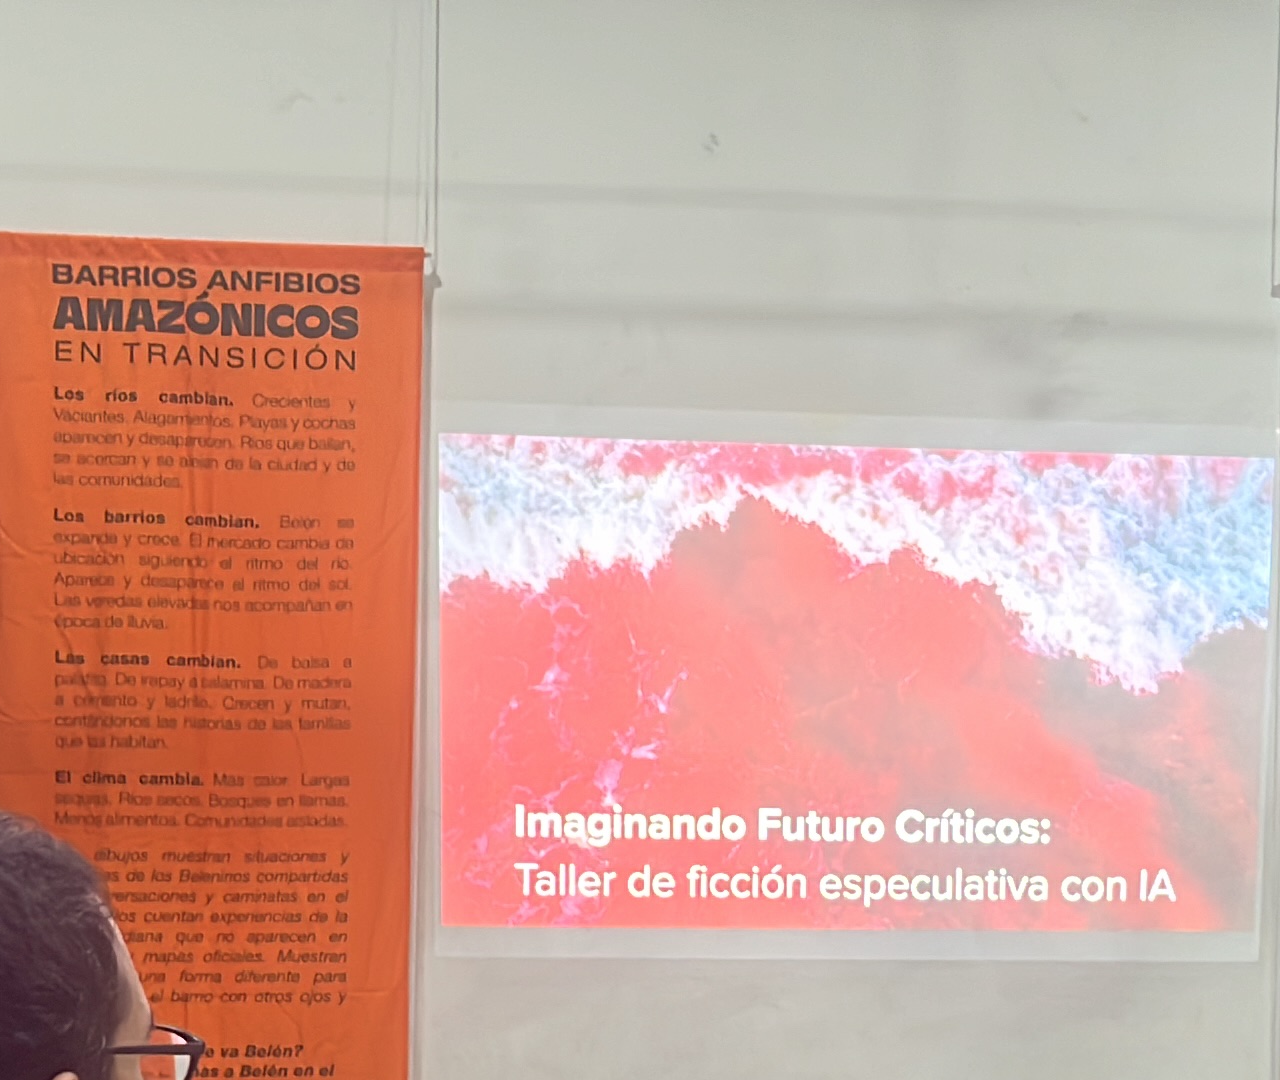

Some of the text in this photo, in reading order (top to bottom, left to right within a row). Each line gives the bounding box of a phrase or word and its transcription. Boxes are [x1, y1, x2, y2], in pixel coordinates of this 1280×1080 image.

[52, 263, 361, 296] BARRIOS ANFIBIOS
[53, 289, 359, 339] AMAZÓNICOS
[55, 340, 357, 371] EN TRANSICIÓN
[54, 386, 84, 401] Los
[159, 391, 234, 407] cambian.
[348, 399, 356, 412] y
[239, 414, 356, 432] Playas y cochas
[126, 434, 305, 452] y que
[142, 456, 355, 474] y de la ciudad y de
[54, 508, 84, 522] Los
[104, 510, 166, 524] barrios
[185, 513, 260, 529] cambian.
[123, 534, 132, 548] y
[207, 537, 271, 550] mercado
[276, 538, 330, 550] cambia
[246, 556, 283, 571] ritmo
[296, 557, 319, 571] del
[123, 575, 132, 590] y
[252, 578, 290, 592] ritmo
[298, 577, 321, 592] del
[213, 599, 240, 612] nos
[104, 616, 124, 629] de
[55, 650, 85, 665] Las
[100, 653, 150, 666] casas
[166, 653, 241, 669] cambian.
[257, 655, 279, 669] De
[115, 672, 137, 686] De
[273, 675, 294, 690] De
[147, 696, 292, 714] y Crecen y
[247, 718, 266, 731] de
[55, 770, 71, 784] El
[82, 771, 127, 785] clima
[139, 771, 204, 786] cambia.
[514, 803, 1052, 848] Imaginando Futuro Críticos:
[161, 849, 231, 863] muestran
[244, 850, 327, 864] situaciones
[340, 851, 351, 866] y
[125, 868, 145, 883] de
[150, 868, 172, 883] los
[256, 870, 349, 887] compartidas
[514, 863, 1177, 907] Taller de ficción especulativa con IA
[205, 893, 214, 906] y
[223, 891, 298, 904] caminatas
[307, 892, 326, 904] en
[335, 889, 350, 904] el
[143, 911, 204, 923] cuentan
[210, 911, 302, 926] experiencias
[309, 910, 329, 923] de
[336, 909, 348, 924] la
[176, 932, 204, 946] que
[216, 932, 235, 943] no
[247, 931, 317, 946] aparecen
[328, 932, 348, 943] en
[143, 949, 347, 967] mapas Muestran
[180, 969, 222, 984] forma
[235, 969, 301, 984] diferente
[313, 972, 347, 986] para
[150, 988, 164, 1004] el
[220, 991, 247, 1004] con
[254, 991, 293, 1004] otros
[300, 990, 332, 1006] ojos
[338, 991, 347, 1006] y
[220, 1046, 239, 1058] va
[244, 1044, 304, 1059] Belén?
[223, 1066, 235, 1078] a
[239, 1064, 289, 1079] Belén
[293, 1065, 314, 1078] en
[319, 1063, 335, 1077] el
